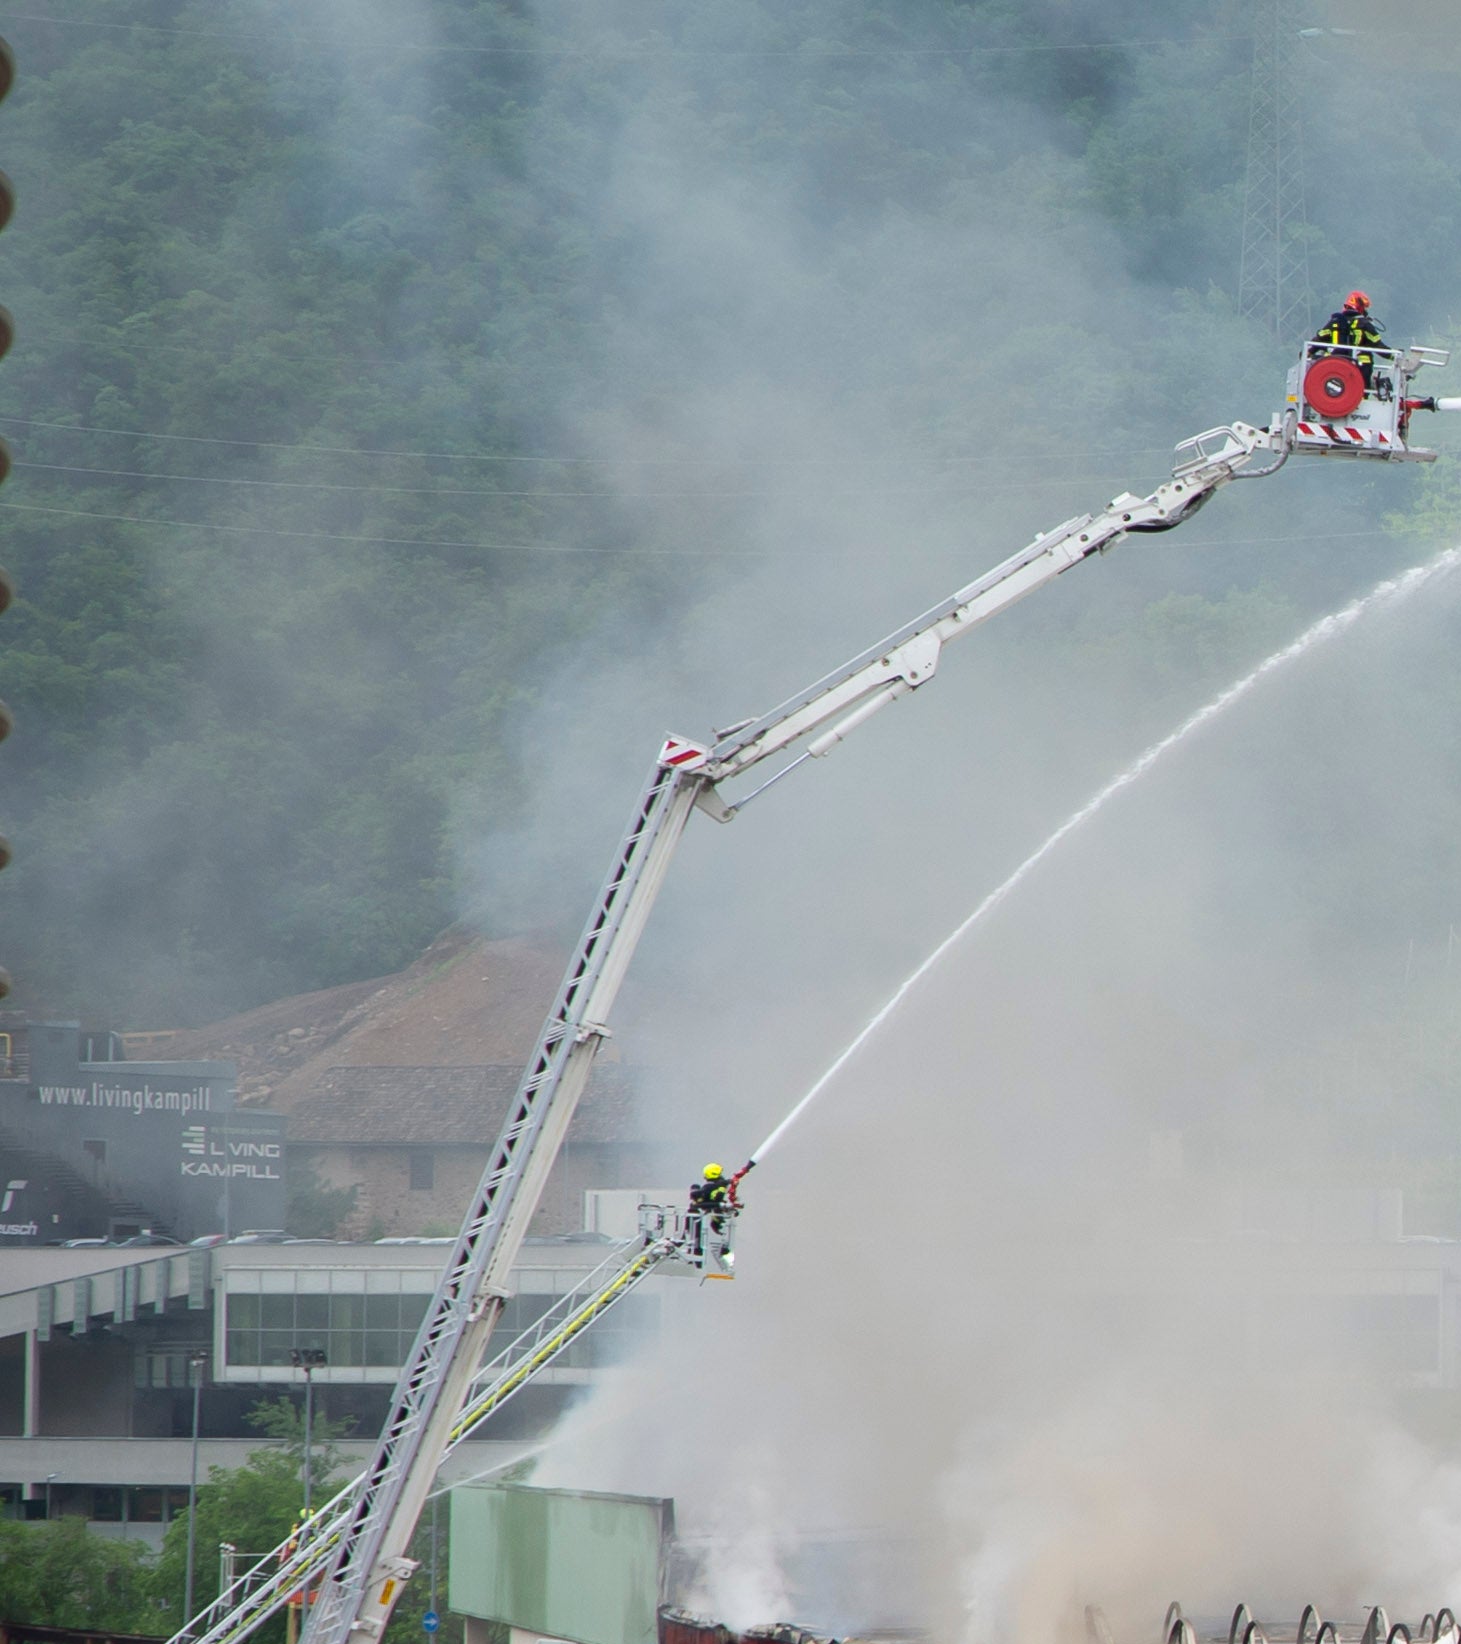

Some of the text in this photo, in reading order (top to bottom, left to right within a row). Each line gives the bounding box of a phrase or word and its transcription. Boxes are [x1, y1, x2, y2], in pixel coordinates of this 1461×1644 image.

[39, 1082, 210, 1116] www.livingkampill
[211, 1143, 280, 1158] LVING
[181, 1162, 280, 1179] KAMPILL
